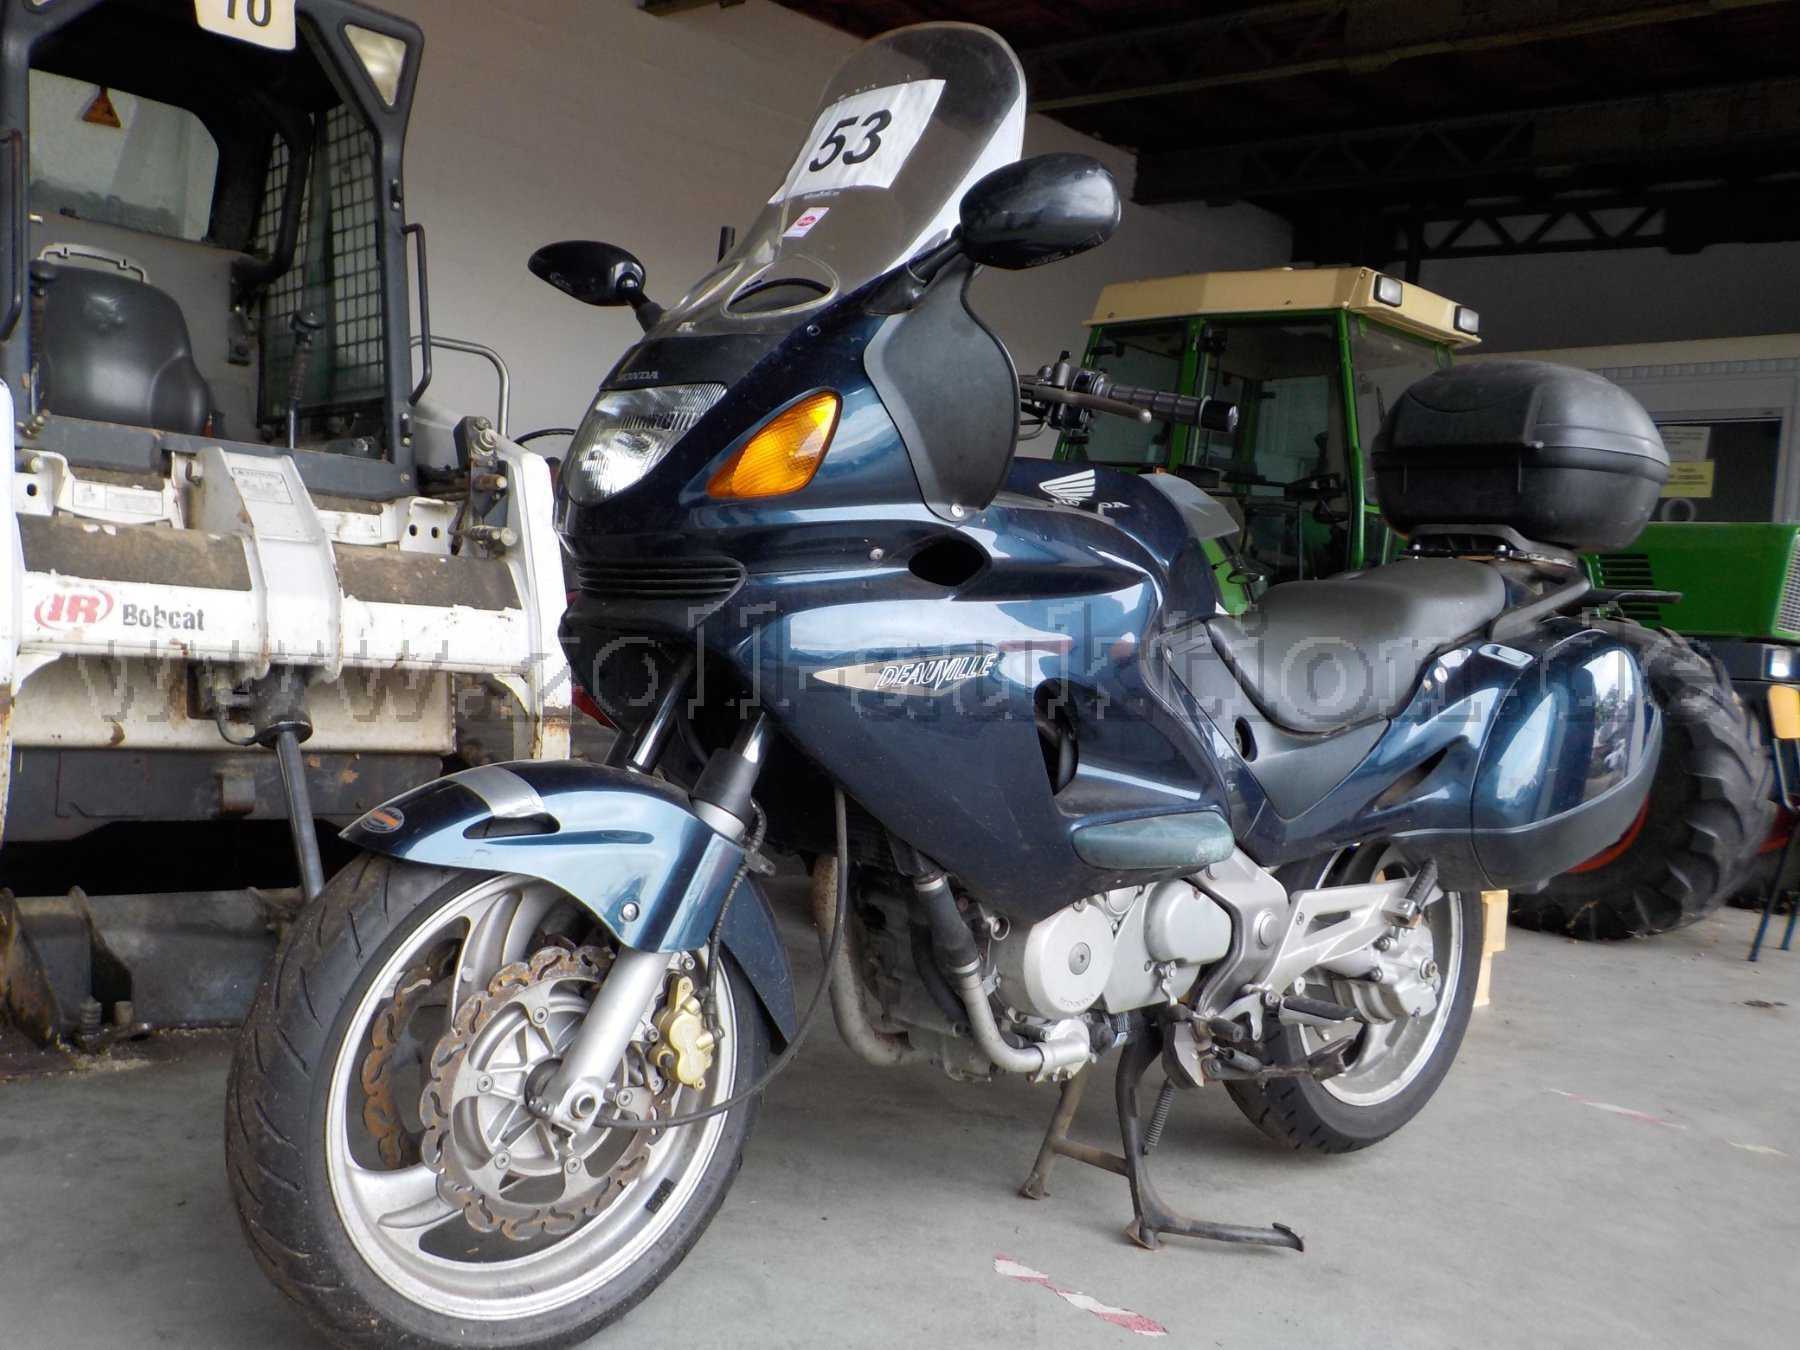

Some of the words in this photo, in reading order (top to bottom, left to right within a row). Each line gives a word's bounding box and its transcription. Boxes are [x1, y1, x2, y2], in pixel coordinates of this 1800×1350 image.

[808, 109, 892, 172] 53
[47, 594, 101, 624] IR
[122, 603, 205, 631] Bobcat
[874, 653, 998, 691] DEAUVILLE
